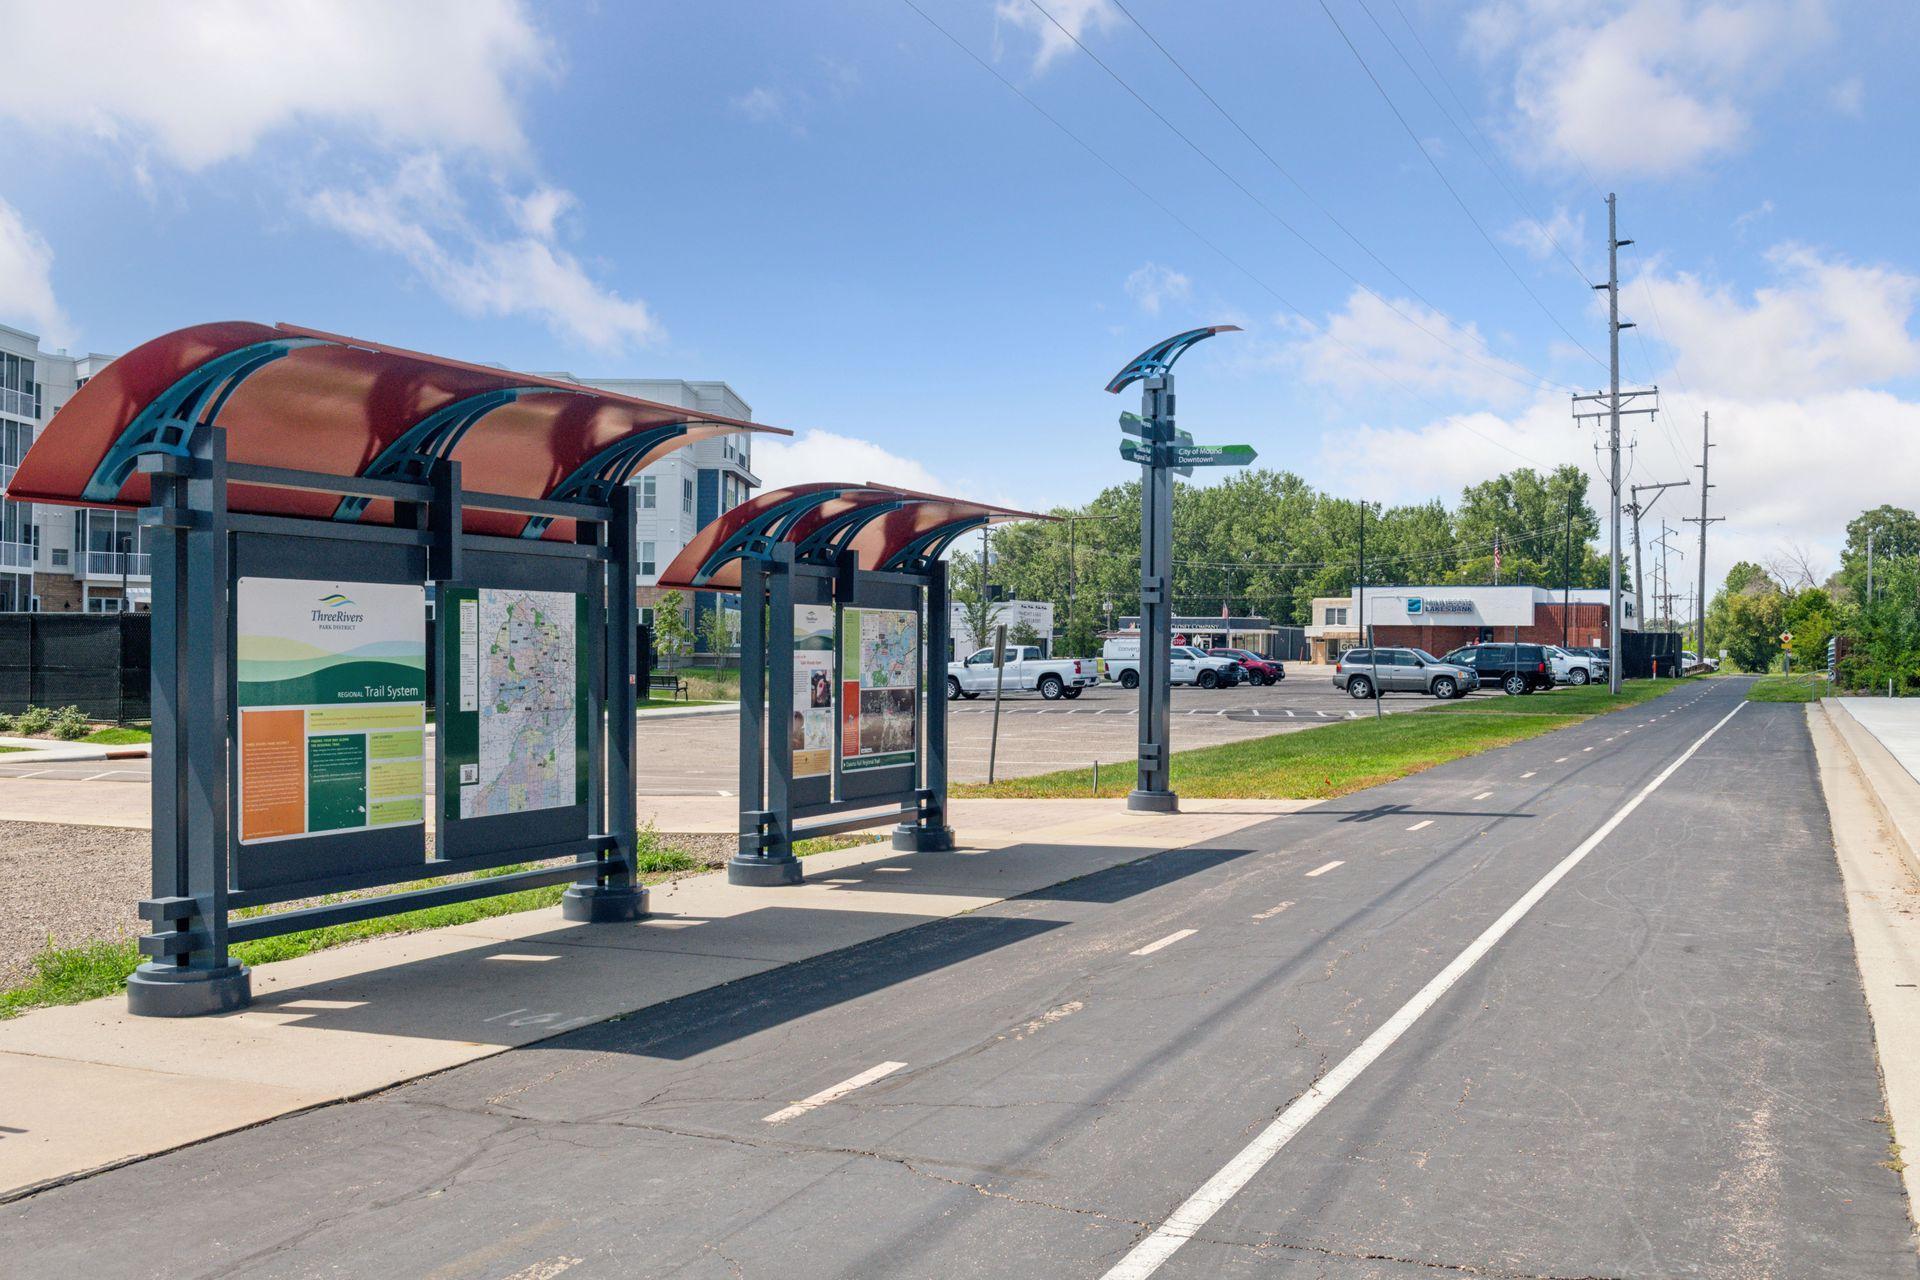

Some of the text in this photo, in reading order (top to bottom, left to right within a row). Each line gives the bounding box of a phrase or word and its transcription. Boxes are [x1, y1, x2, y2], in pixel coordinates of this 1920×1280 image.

[1178, 448, 1191, 456] City
[311, 609, 363, 623] ThreeRivers
[365, 686, 385, 698] Trail
[387, 685, 418, 699] System
